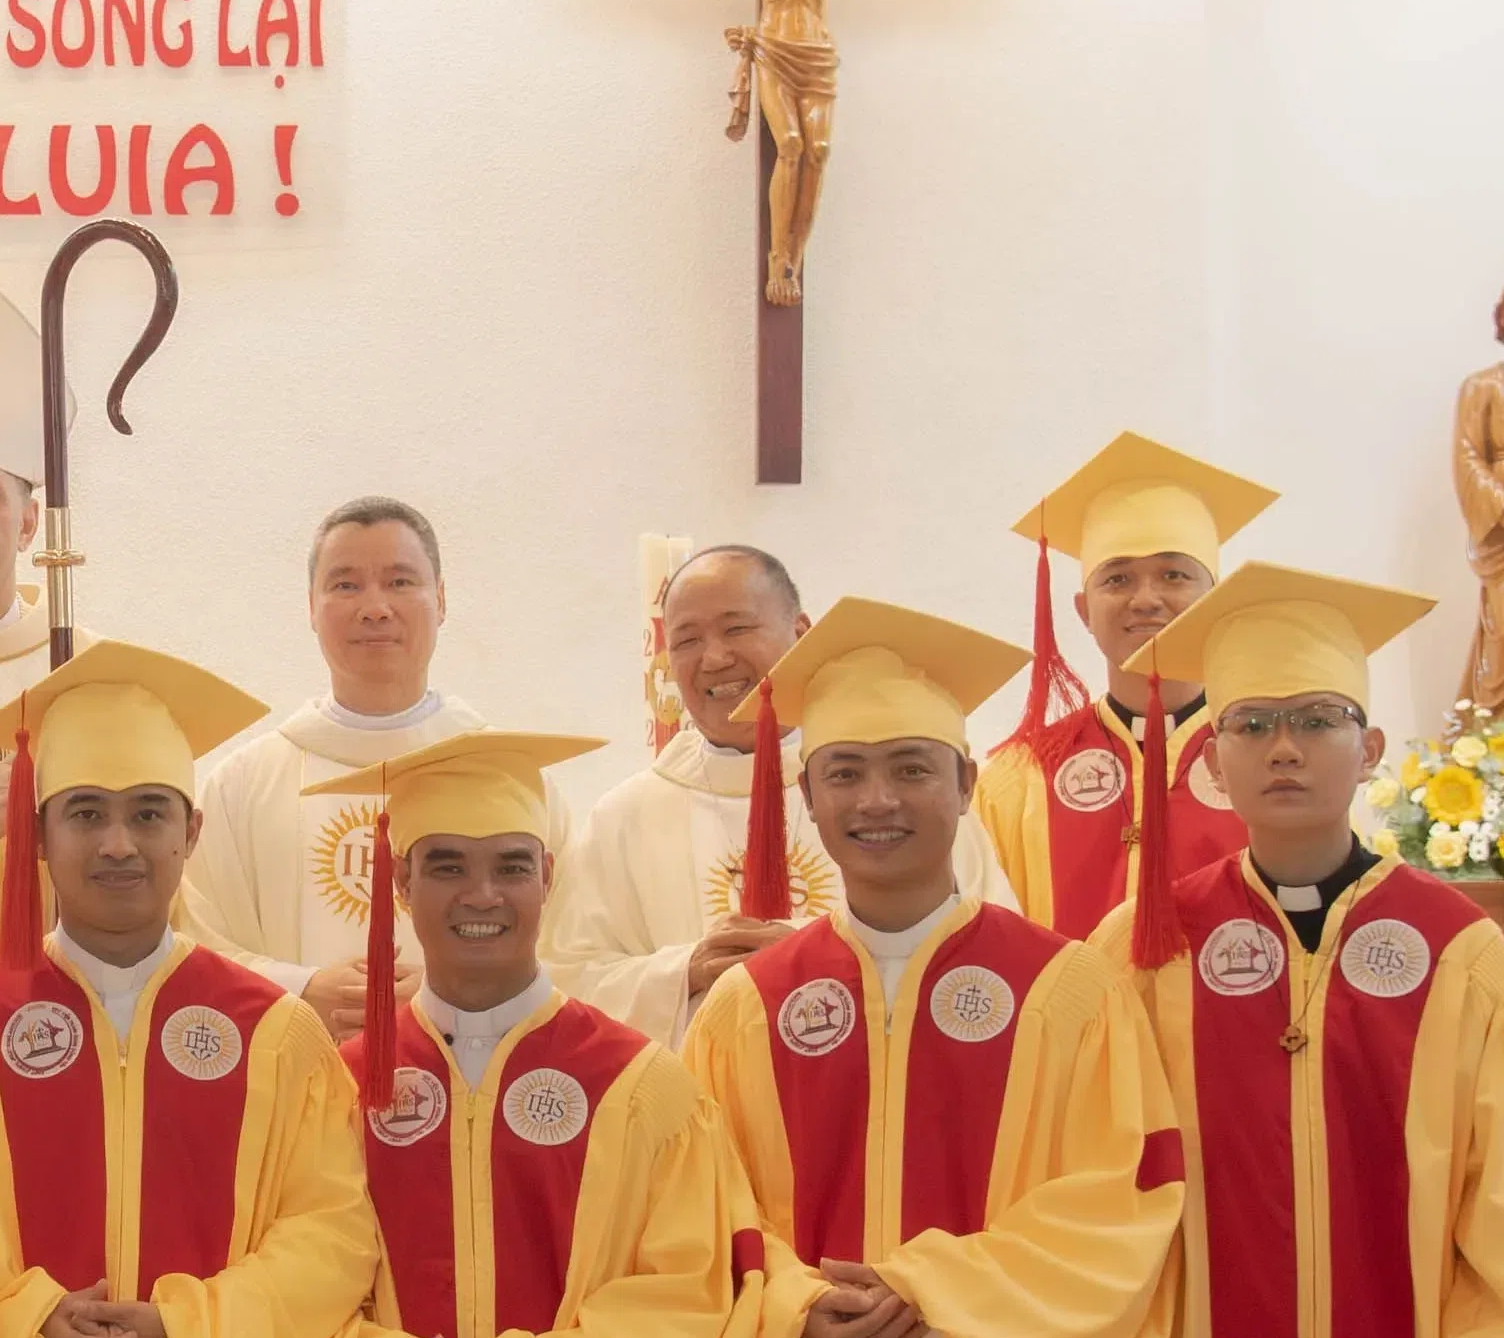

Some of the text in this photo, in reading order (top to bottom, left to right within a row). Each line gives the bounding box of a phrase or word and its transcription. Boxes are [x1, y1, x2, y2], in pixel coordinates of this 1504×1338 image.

[273, 123, 301, 218] !
[1366, 946, 1406, 970] IHS
[954, 992, 993, 1014] IHS
[183, 1030, 222, 1053] IHS
[527, 1093, 567, 1119] IHS
